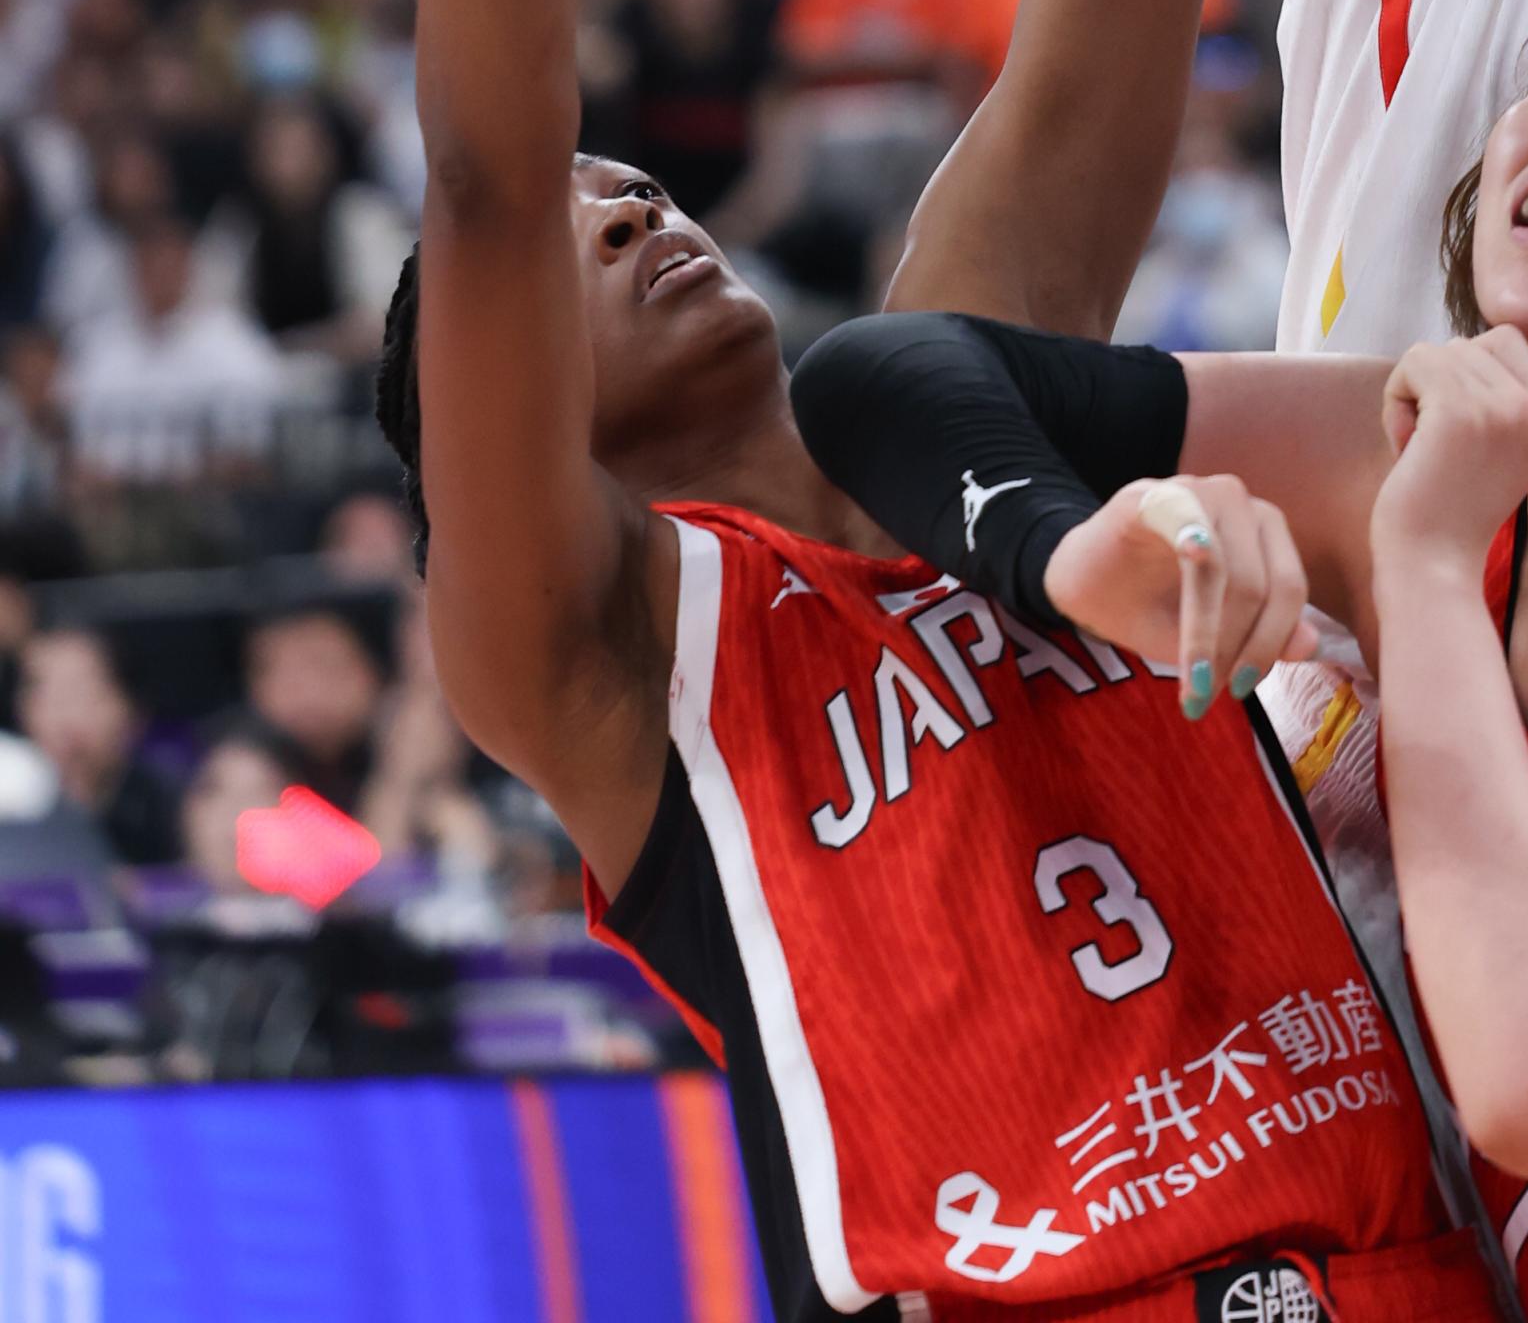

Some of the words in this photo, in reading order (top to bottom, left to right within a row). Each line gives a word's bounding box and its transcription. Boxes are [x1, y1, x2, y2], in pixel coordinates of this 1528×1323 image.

[810, 589, 1182, 849] JAPA
[1032, 833, 1174, 1002] 3
[1055, 978, 1384, 1196] 三井不動産
[1085, 1131, 1245, 1234] MITSUI
